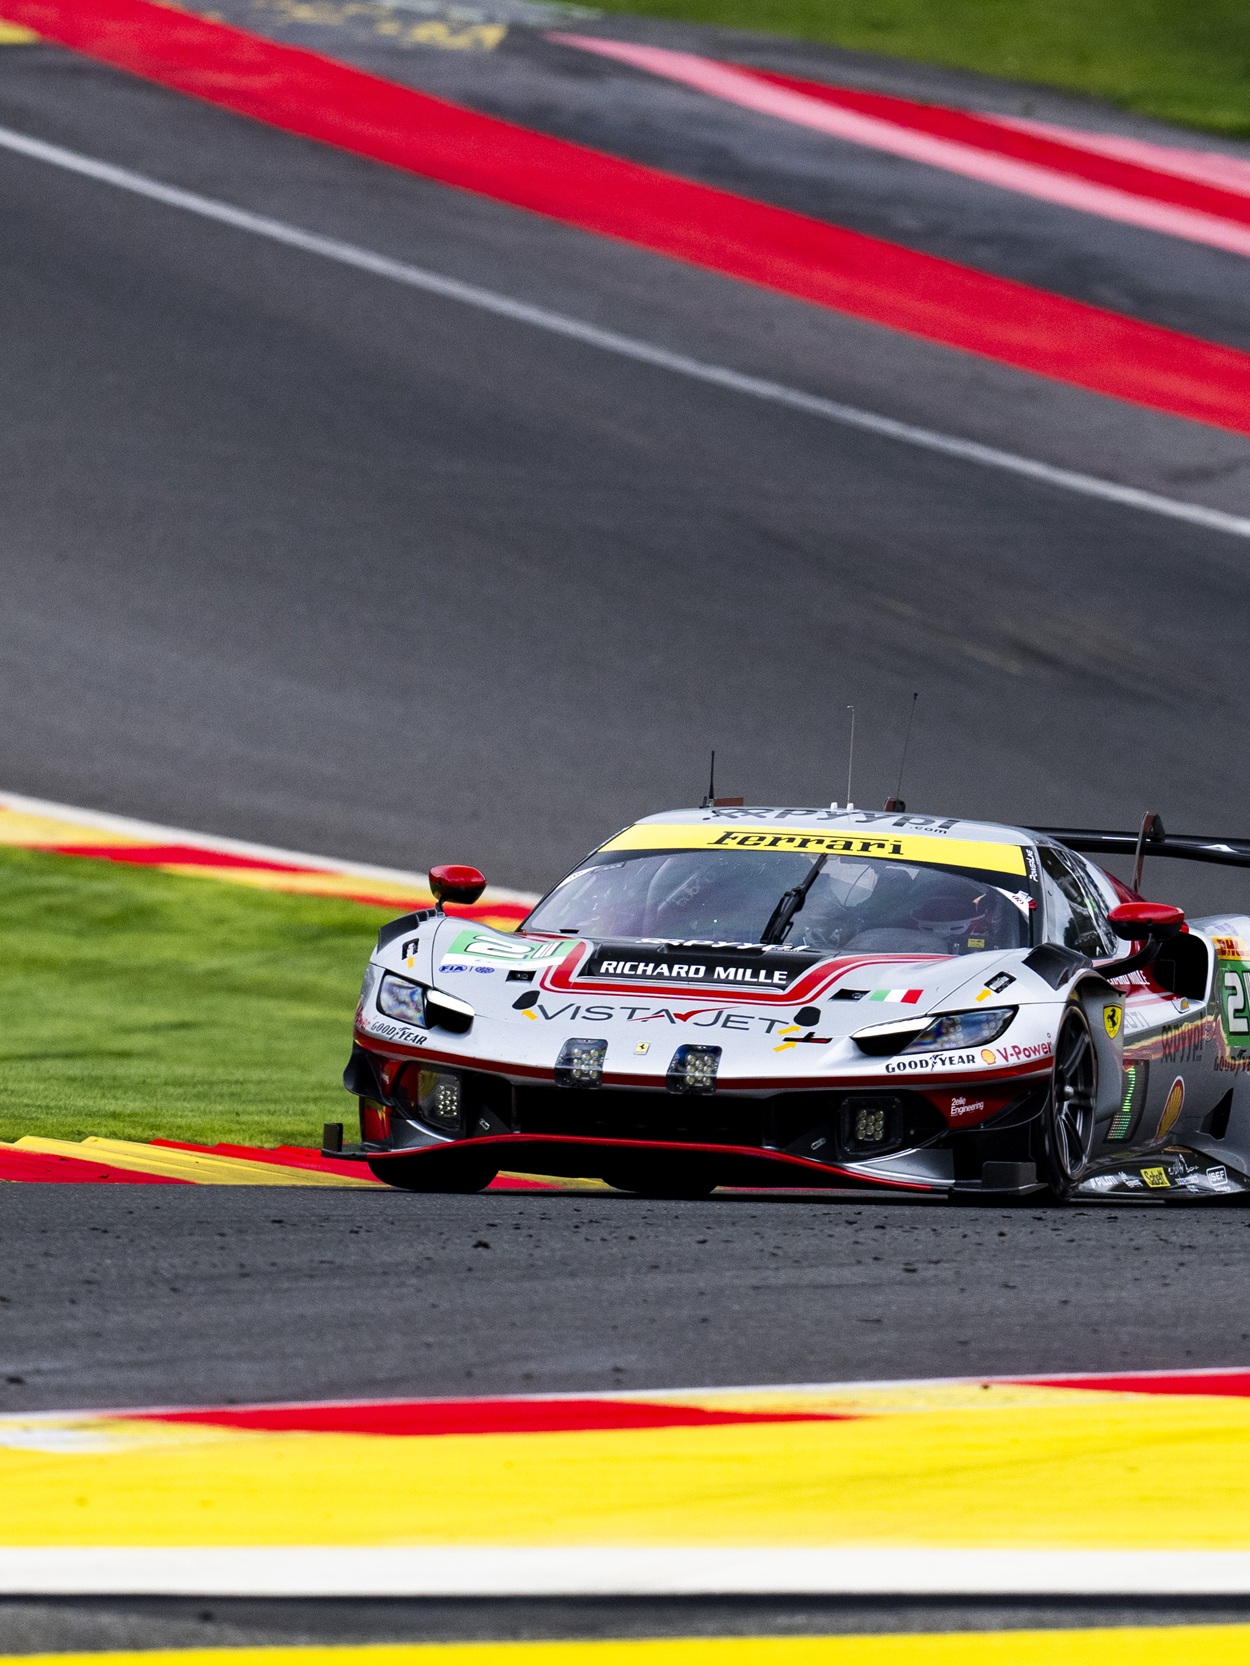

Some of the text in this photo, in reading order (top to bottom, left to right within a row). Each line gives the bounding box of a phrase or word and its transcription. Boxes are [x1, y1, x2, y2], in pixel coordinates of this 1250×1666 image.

[707, 831, 904, 856] Ferrari
[600, 960, 788, 985] RICHARD MILLE
[370, 1021, 428, 1045] GOODYEAR
[885, 1054, 976, 1073] GOODYEAR
[996, 1042, 1052, 1063] V-Power
